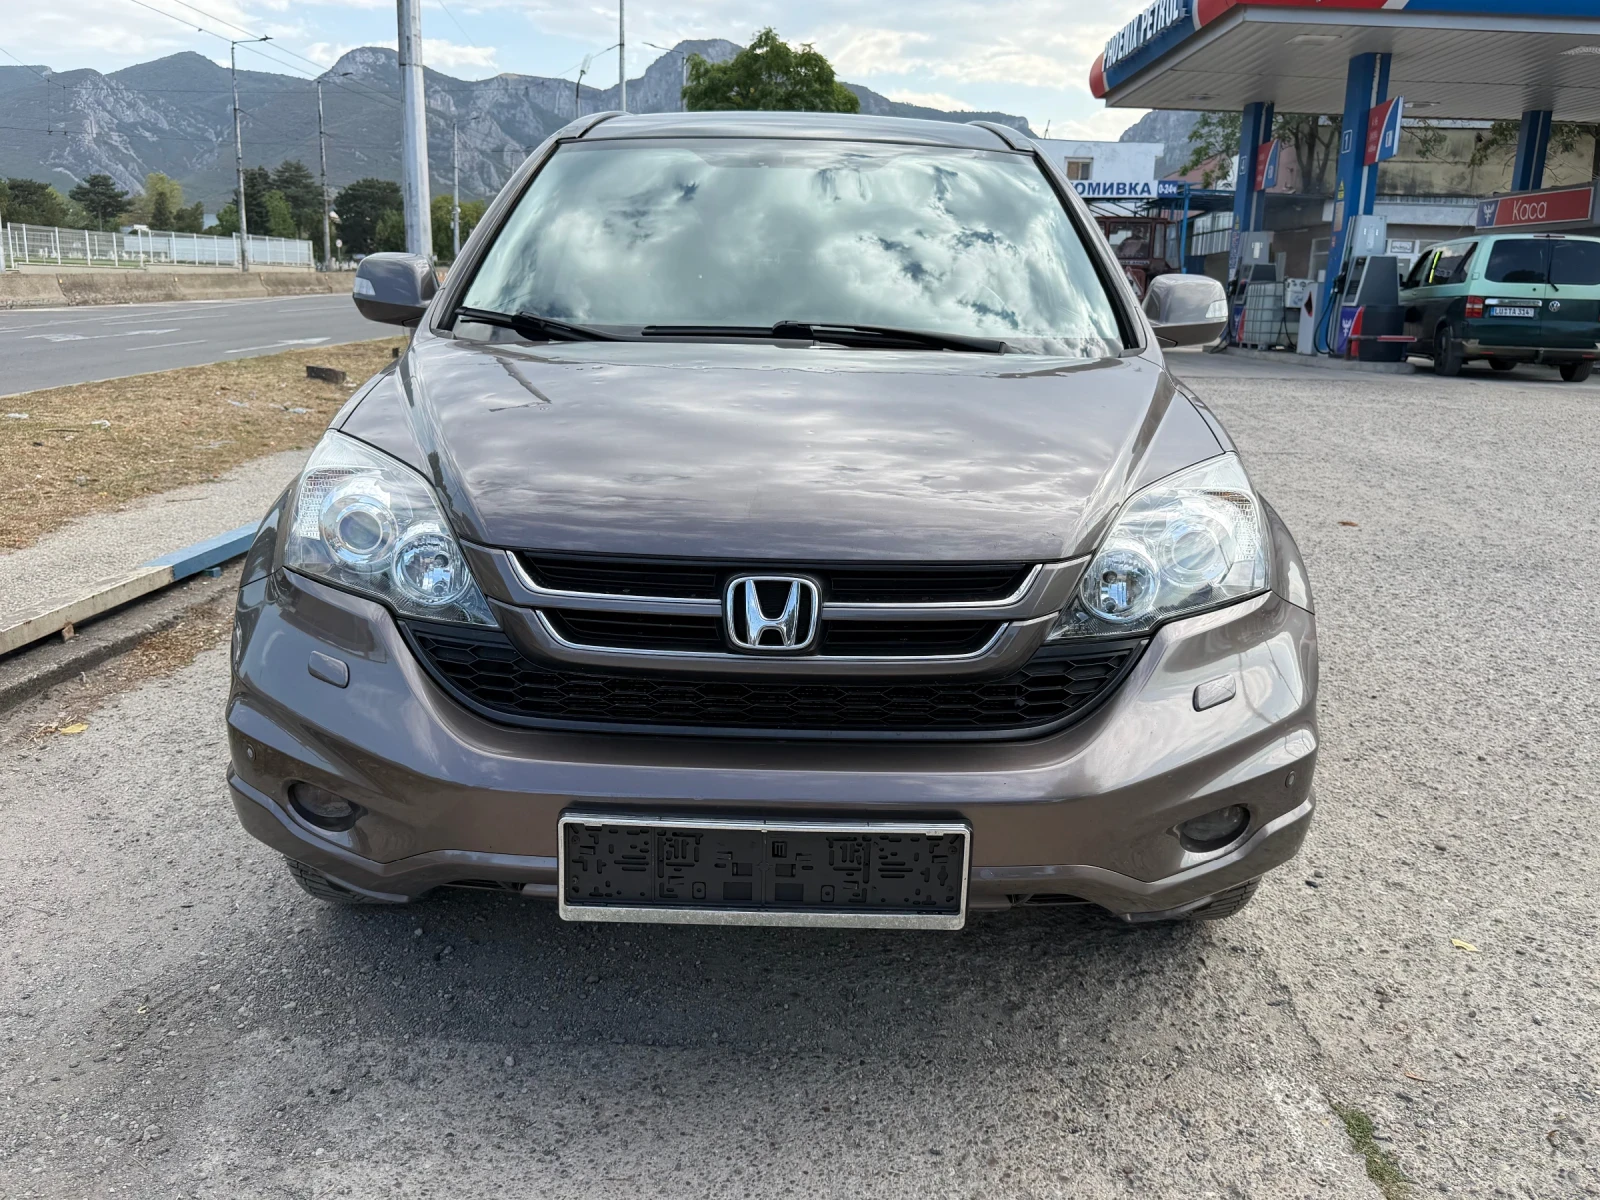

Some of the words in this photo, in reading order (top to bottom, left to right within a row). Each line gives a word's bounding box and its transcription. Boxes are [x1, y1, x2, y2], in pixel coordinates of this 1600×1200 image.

[1101, 16, 1140, 72] PHOENIX
[1140, 0, 1179, 44] PETROL
[1072, 182, 1151, 195] ОМИВКА
